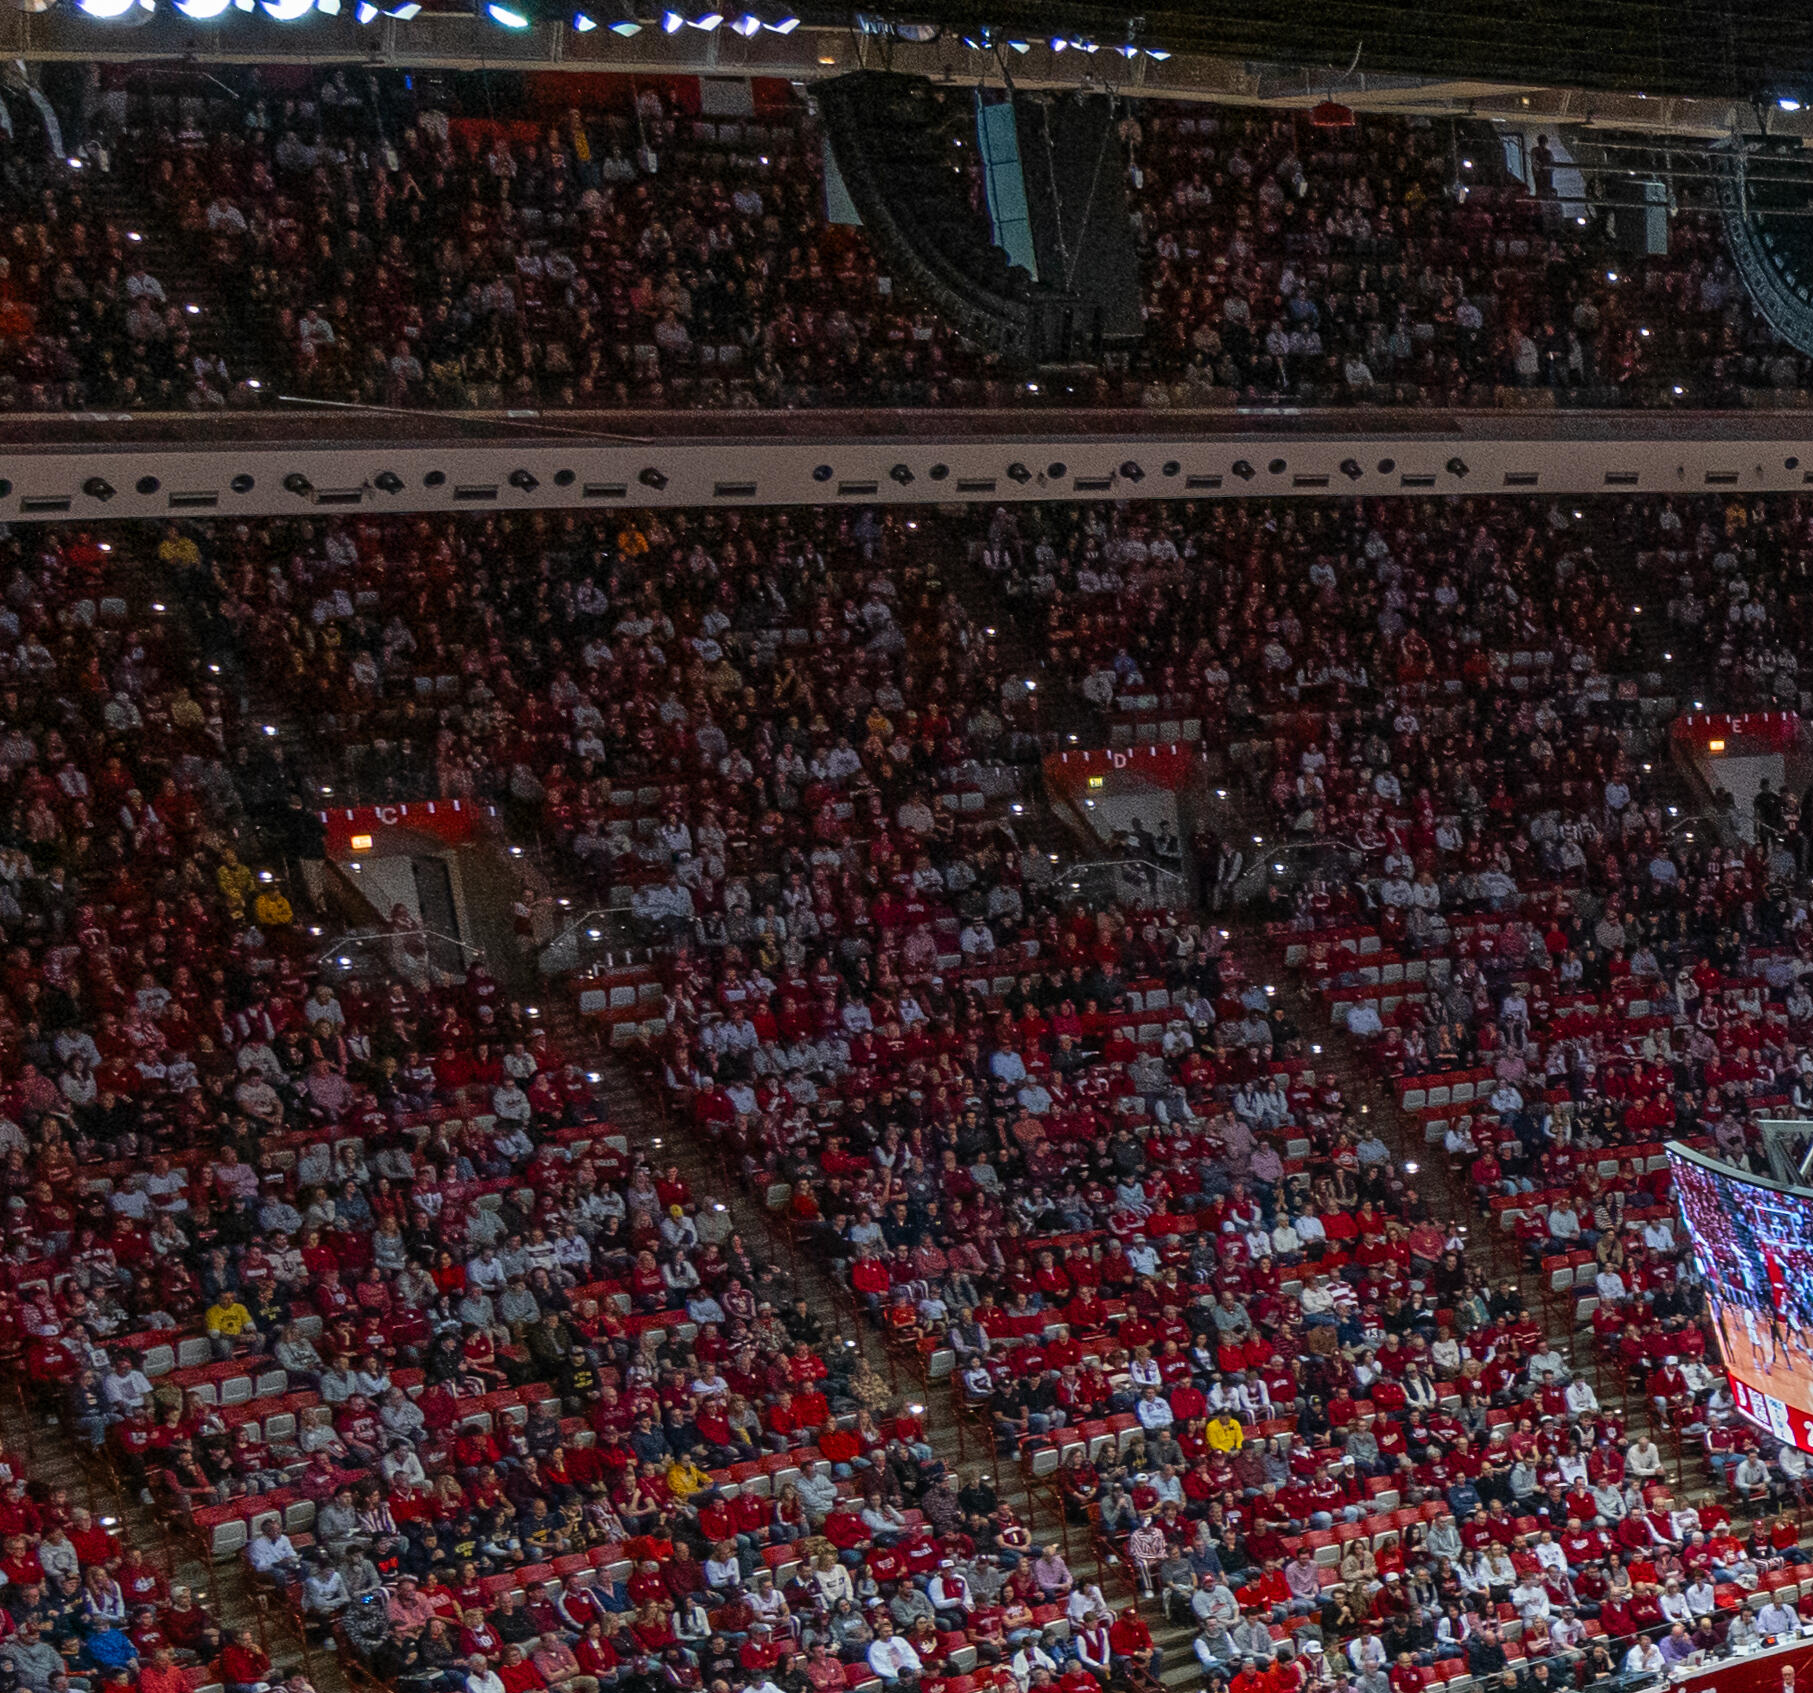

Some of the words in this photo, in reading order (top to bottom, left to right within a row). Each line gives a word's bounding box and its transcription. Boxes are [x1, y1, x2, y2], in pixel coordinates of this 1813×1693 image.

[1732, 720, 1741, 733] E
[1114, 754, 1127, 768] D
[380, 808, 398, 825] C
